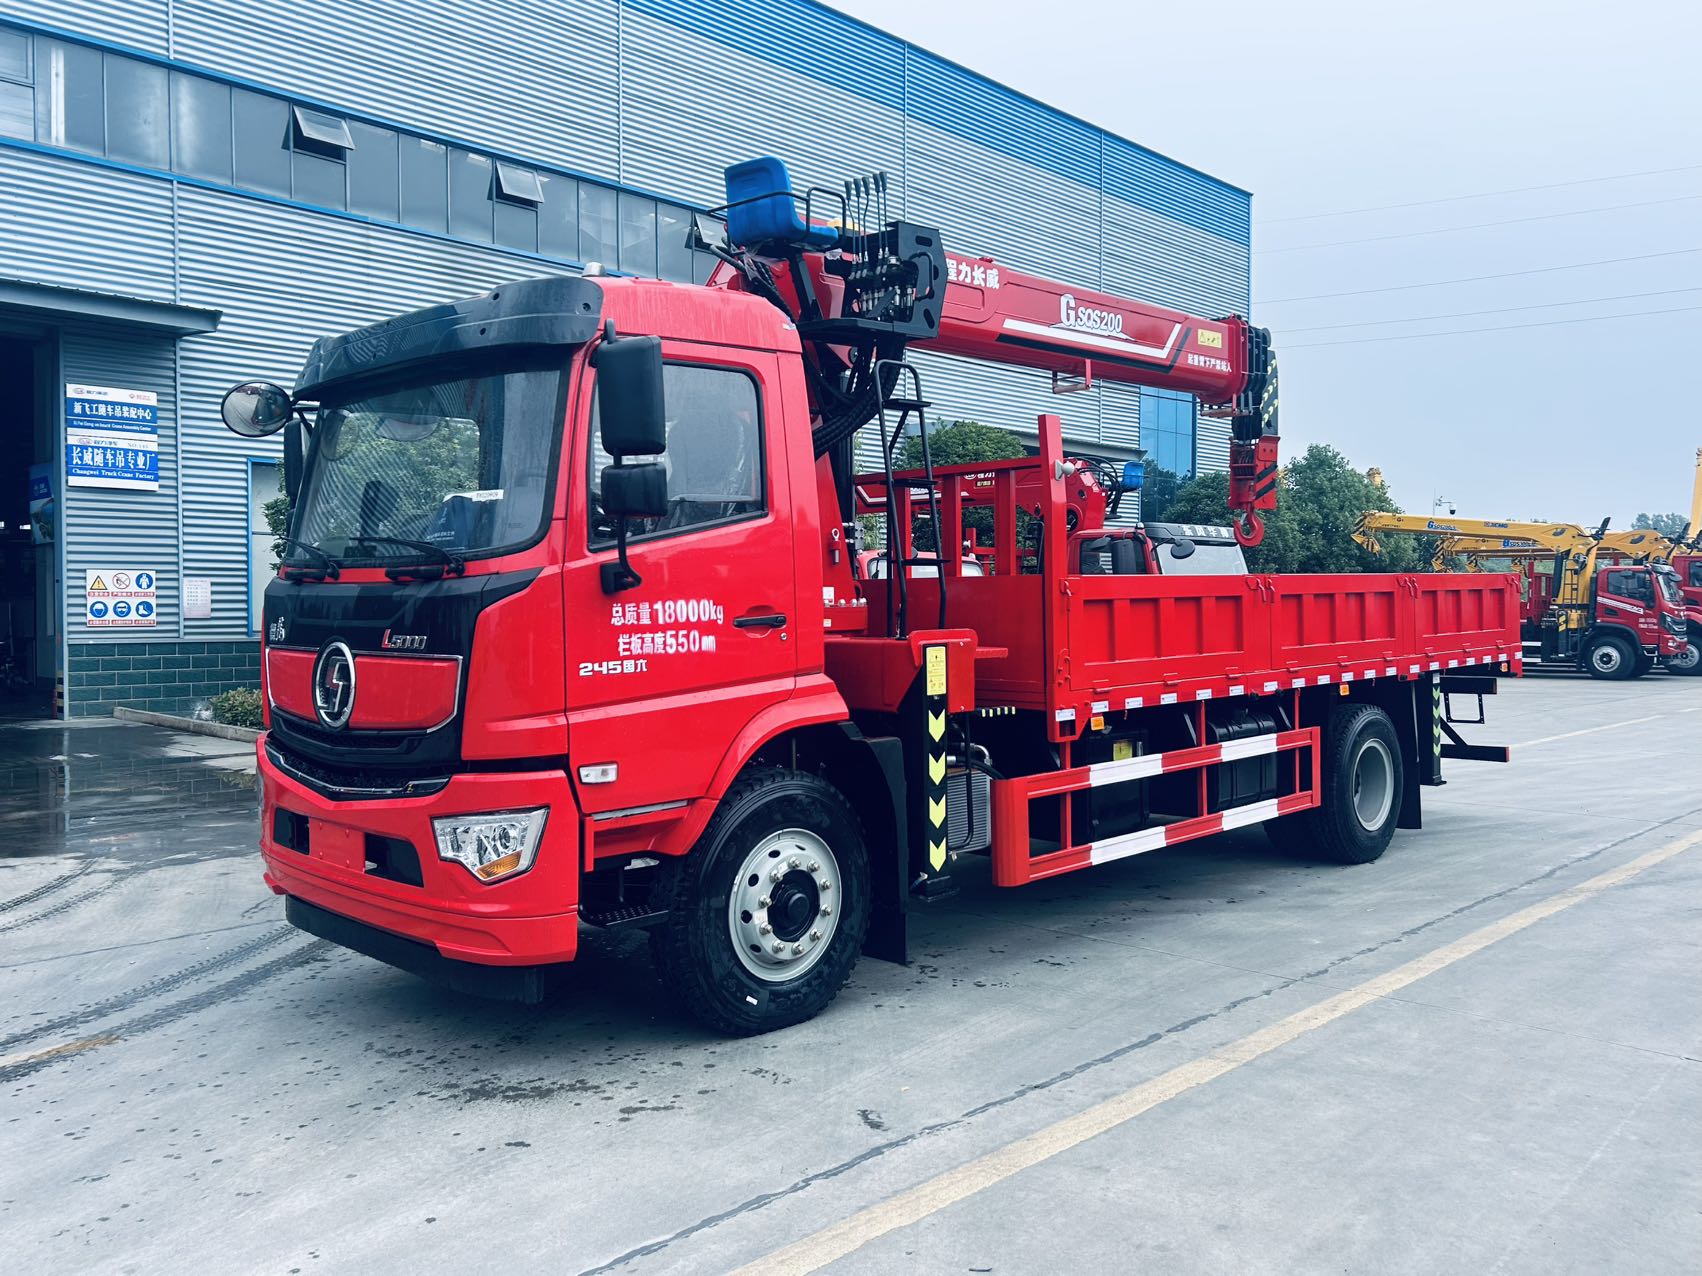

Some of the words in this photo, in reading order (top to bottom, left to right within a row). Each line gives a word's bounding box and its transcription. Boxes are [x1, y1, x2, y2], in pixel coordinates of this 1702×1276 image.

[73, 401, 152, 420] 新飞工随车吊装配中心
[72, 446, 155, 470] 长威随车吊专业厂
[101, 469, 117, 477] Truck
[382, 628, 427, 649] L5000
